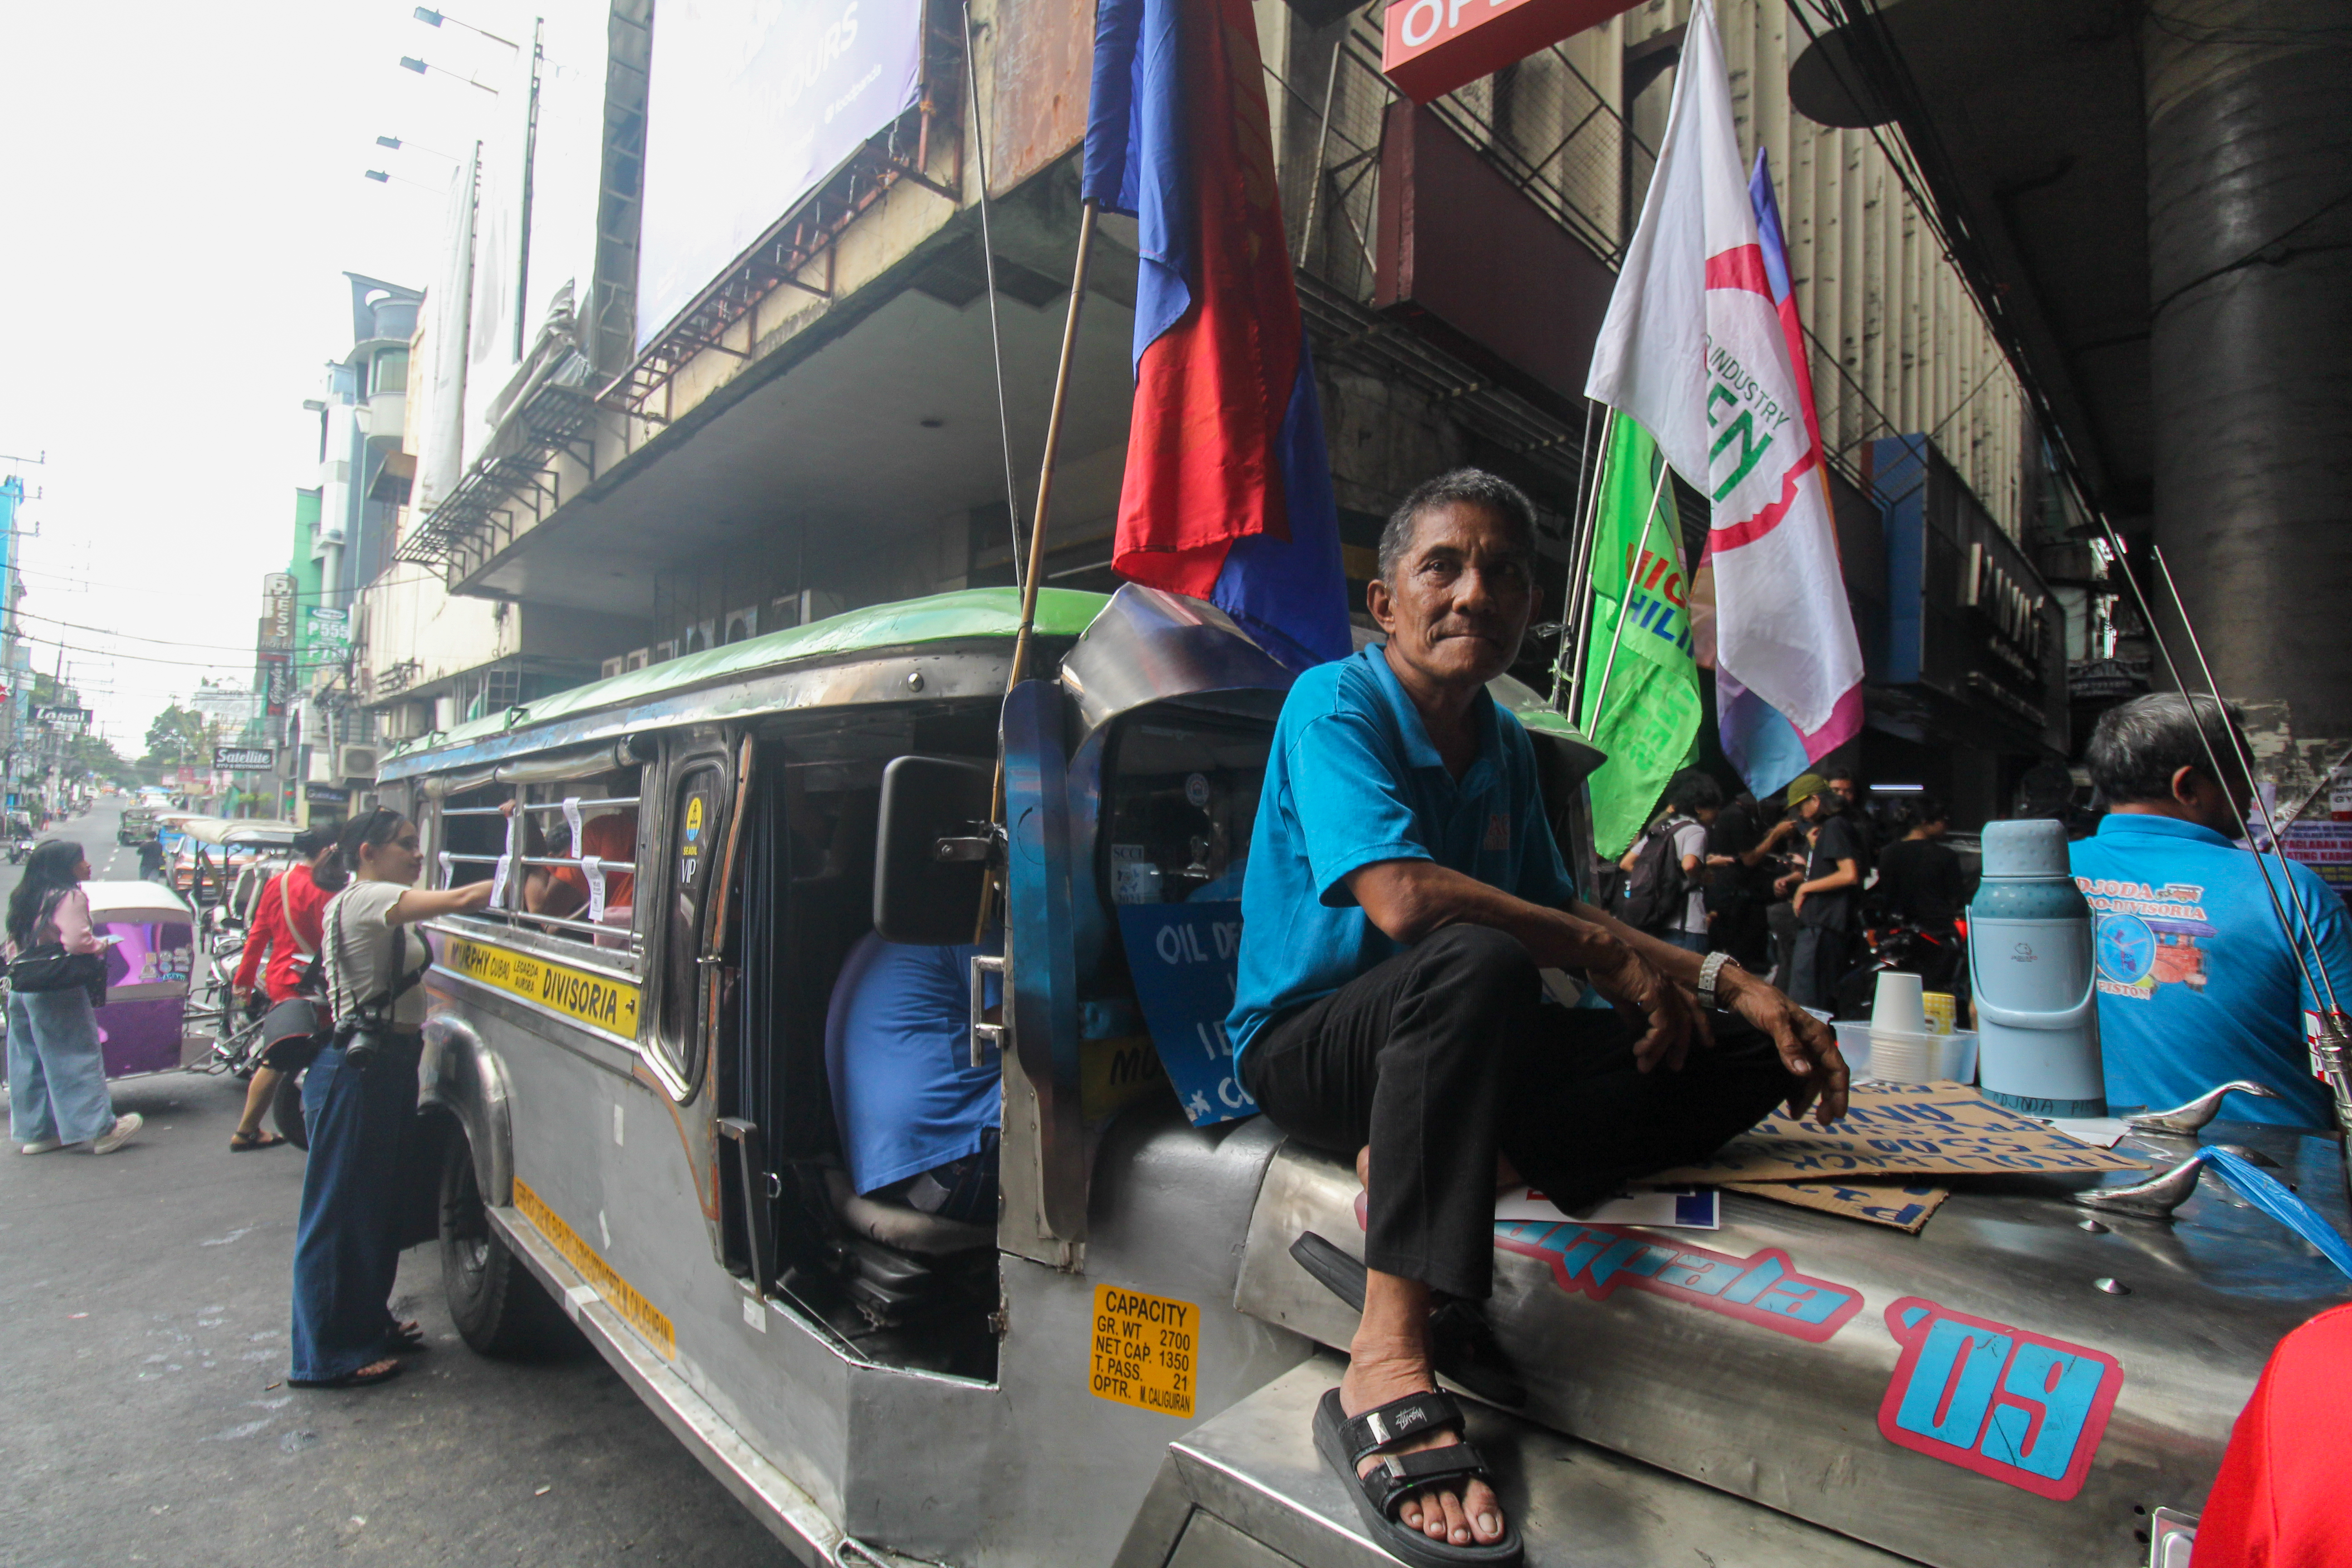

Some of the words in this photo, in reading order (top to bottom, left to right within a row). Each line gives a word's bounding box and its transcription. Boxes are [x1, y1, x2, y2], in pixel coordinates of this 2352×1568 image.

[1709, 347, 1790, 431] INDUSTRY
[216, 748, 271, 764] Satellite
[681, 858, 696, 884] VIP
[451, 941, 490, 977] MURPHY
[1156, 922, 1209, 965] OIL
[543, 969, 618, 1025] DIVISORIA
[2097, 980, 2151, 1000] PISTON
[1106, 1291, 1187, 1328] CAPACITY
[1097, 1315, 1118, 1336] GR.
[1123, 1322, 1142, 1340] WT
[1160, 1329, 1191, 1352] 2700
[1096, 1335, 1121, 1356] NET
[1124, 1341, 1152, 1364] CAP.
[1160, 1350, 1189, 1372] 1350
[1093, 1374, 1131, 1399] OPTR.
[1095, 1354, 1104, 1373] T.
[1108, 1357, 1143, 1382] PASS.
[1174, 1373, 1188, 1392] 21
